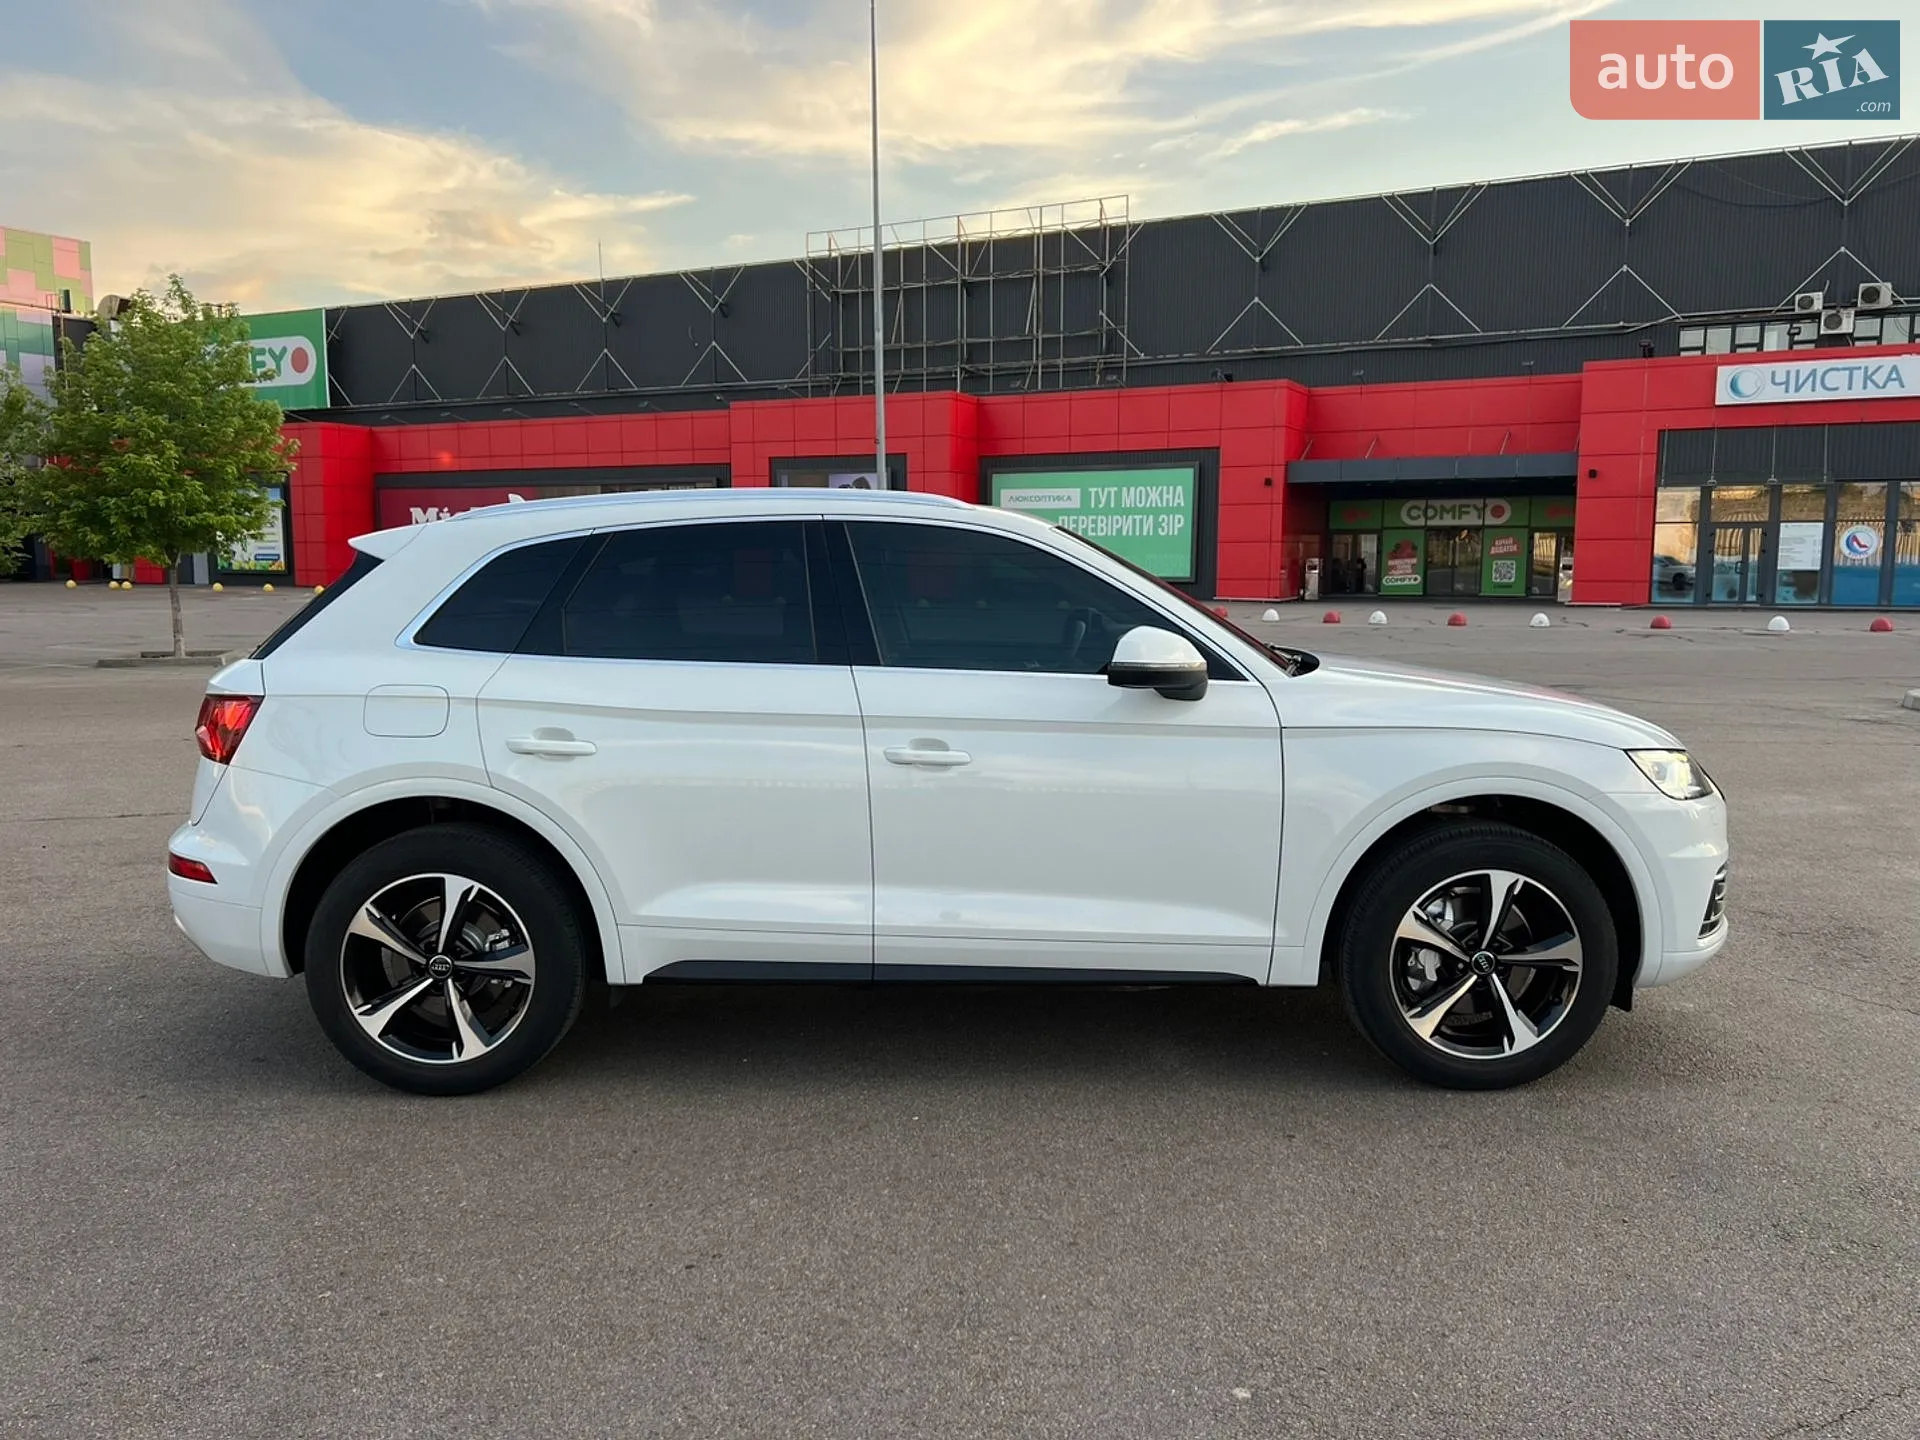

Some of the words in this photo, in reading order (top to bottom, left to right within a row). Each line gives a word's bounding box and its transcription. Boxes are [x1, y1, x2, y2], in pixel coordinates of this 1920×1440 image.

[1771, 364, 1905, 393] ЧИСТКА
[1088, 487, 1117, 508] ТУТ
[1121, 485, 1185, 508] МОЖНА
[1406, 502, 1488, 521] COMFY
[1158, 514, 1184, 536] ЗІР
